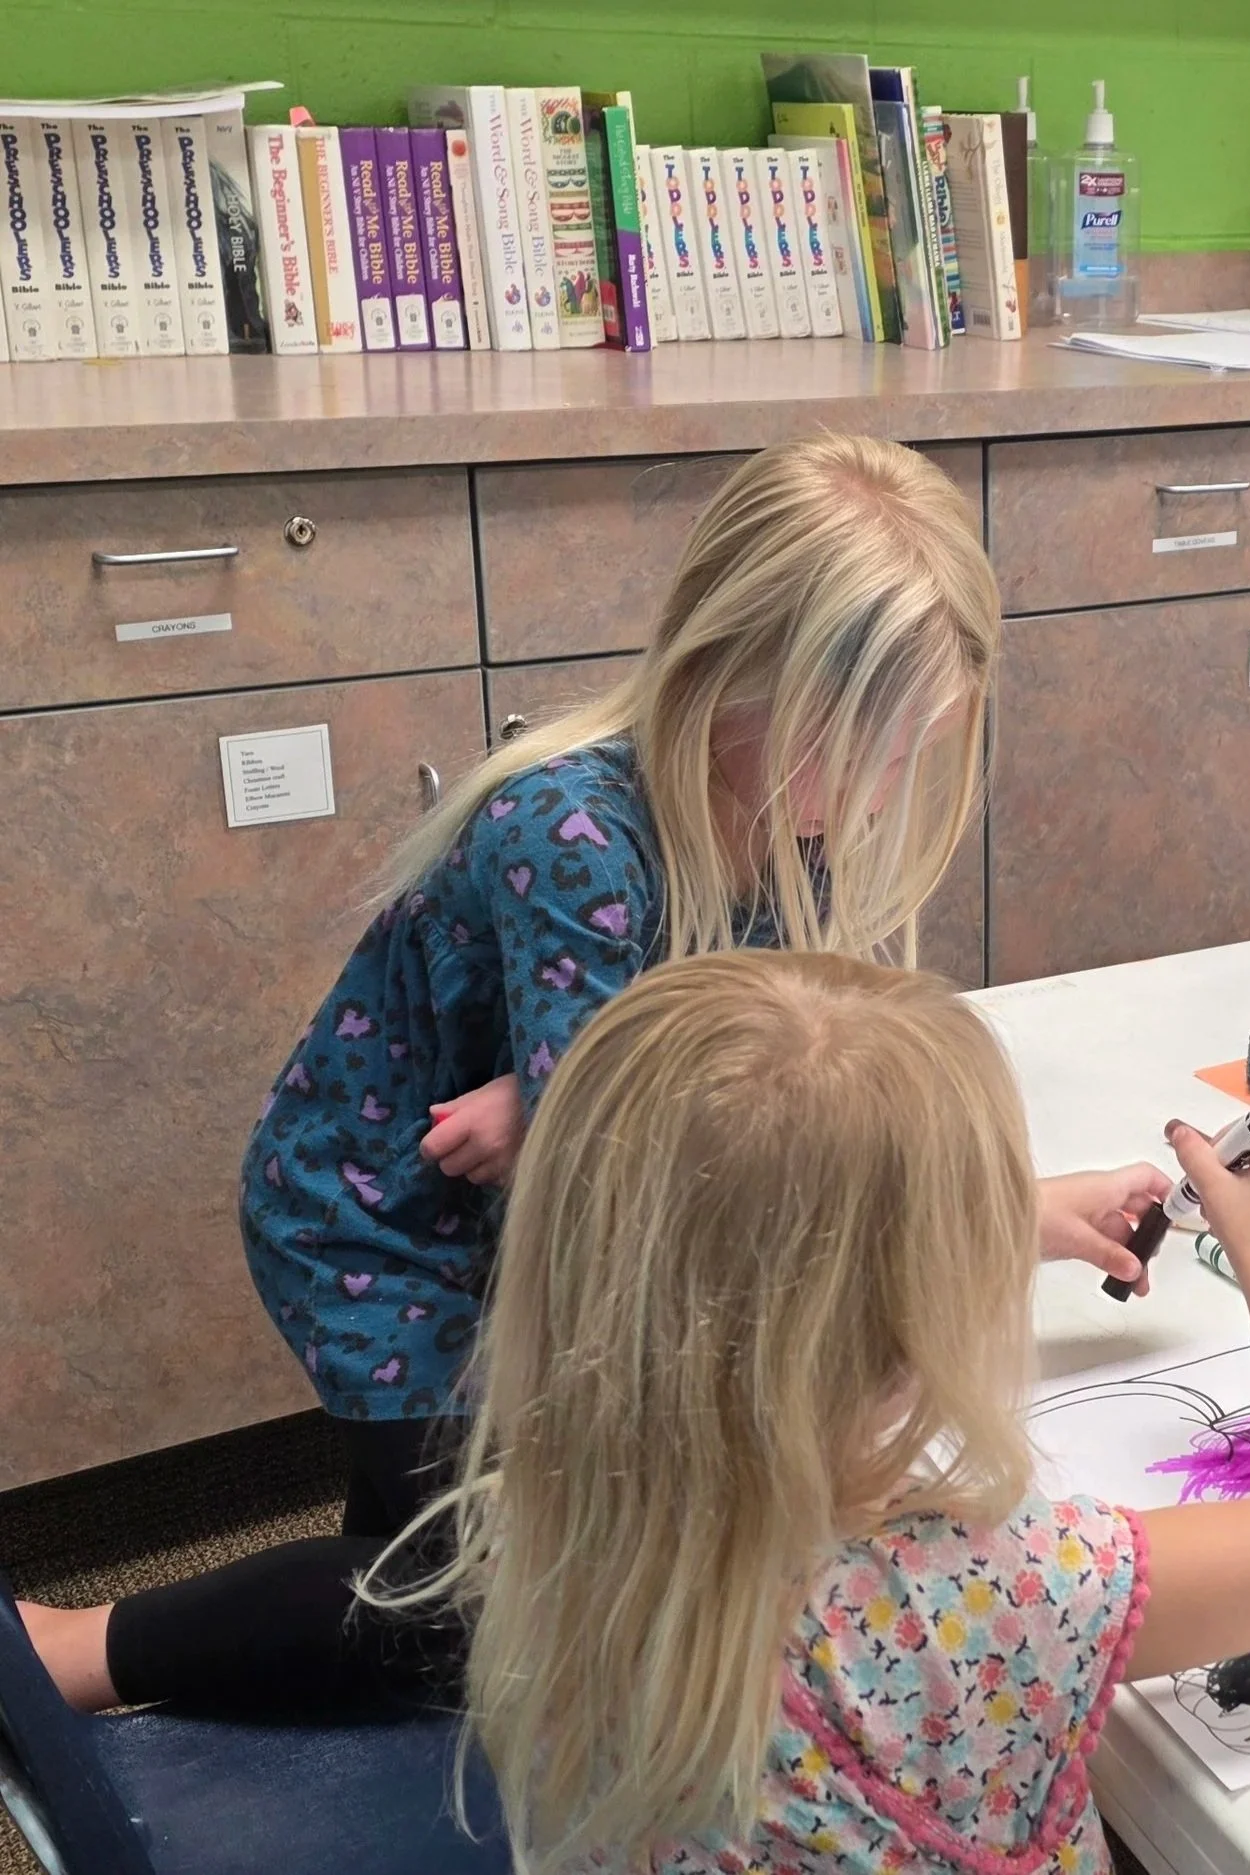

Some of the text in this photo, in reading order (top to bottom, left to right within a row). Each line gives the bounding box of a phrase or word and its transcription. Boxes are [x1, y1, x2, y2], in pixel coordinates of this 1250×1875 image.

[490, 115, 506, 162] Word
[520, 118, 536, 166] Word
[360, 160, 376, 198] Read
[396, 160, 412, 198] Read
[430, 161, 446, 198] Read
[494, 165, 508, 186] &
[525, 168, 538, 189] &
[922, 160, 930, 187] LLAMA
[315, 136, 339, 274] THE BEGINNER'S BIBLE
[353, 196, 362, 215] Story
[388, 196, 397, 215] Story
[423, 196, 432, 215] Story
[497, 188, 510, 229] Song
[527, 190, 540, 232] Song
[925, 188, 933, 214] LLAMA
[268, 134, 299, 296] The Beginner's Bible
[356, 217, 365, 235] Bible
[366, 215, 380, 239] Me
[391, 217, 400, 235] Bible
[401, 215, 414, 239] Me
[426, 217, 435, 235] Bible
[436, 215, 449, 239] Me
[1085, 214, 1118, 227] Purell
[227, 195, 247, 273] HOLY BIBLE
[360, 248, 369, 281] Children
[369, 242, 385, 284] Bible
[394, 248, 403, 280] Children
[404, 242, 419, 284] Bible
[429, 248, 439, 280] Children
[439, 242, 454, 284] Bible
[501, 233, 517, 274] Bible
[532, 236, 547, 277] Bible
[932, 243, 940, 267] MAMA
[55, 283, 82, 291] Bible
[101, 283, 127, 291] Bible
[144, 282, 170, 290] Bible
[151, 621, 197, 633] CRAYONS
